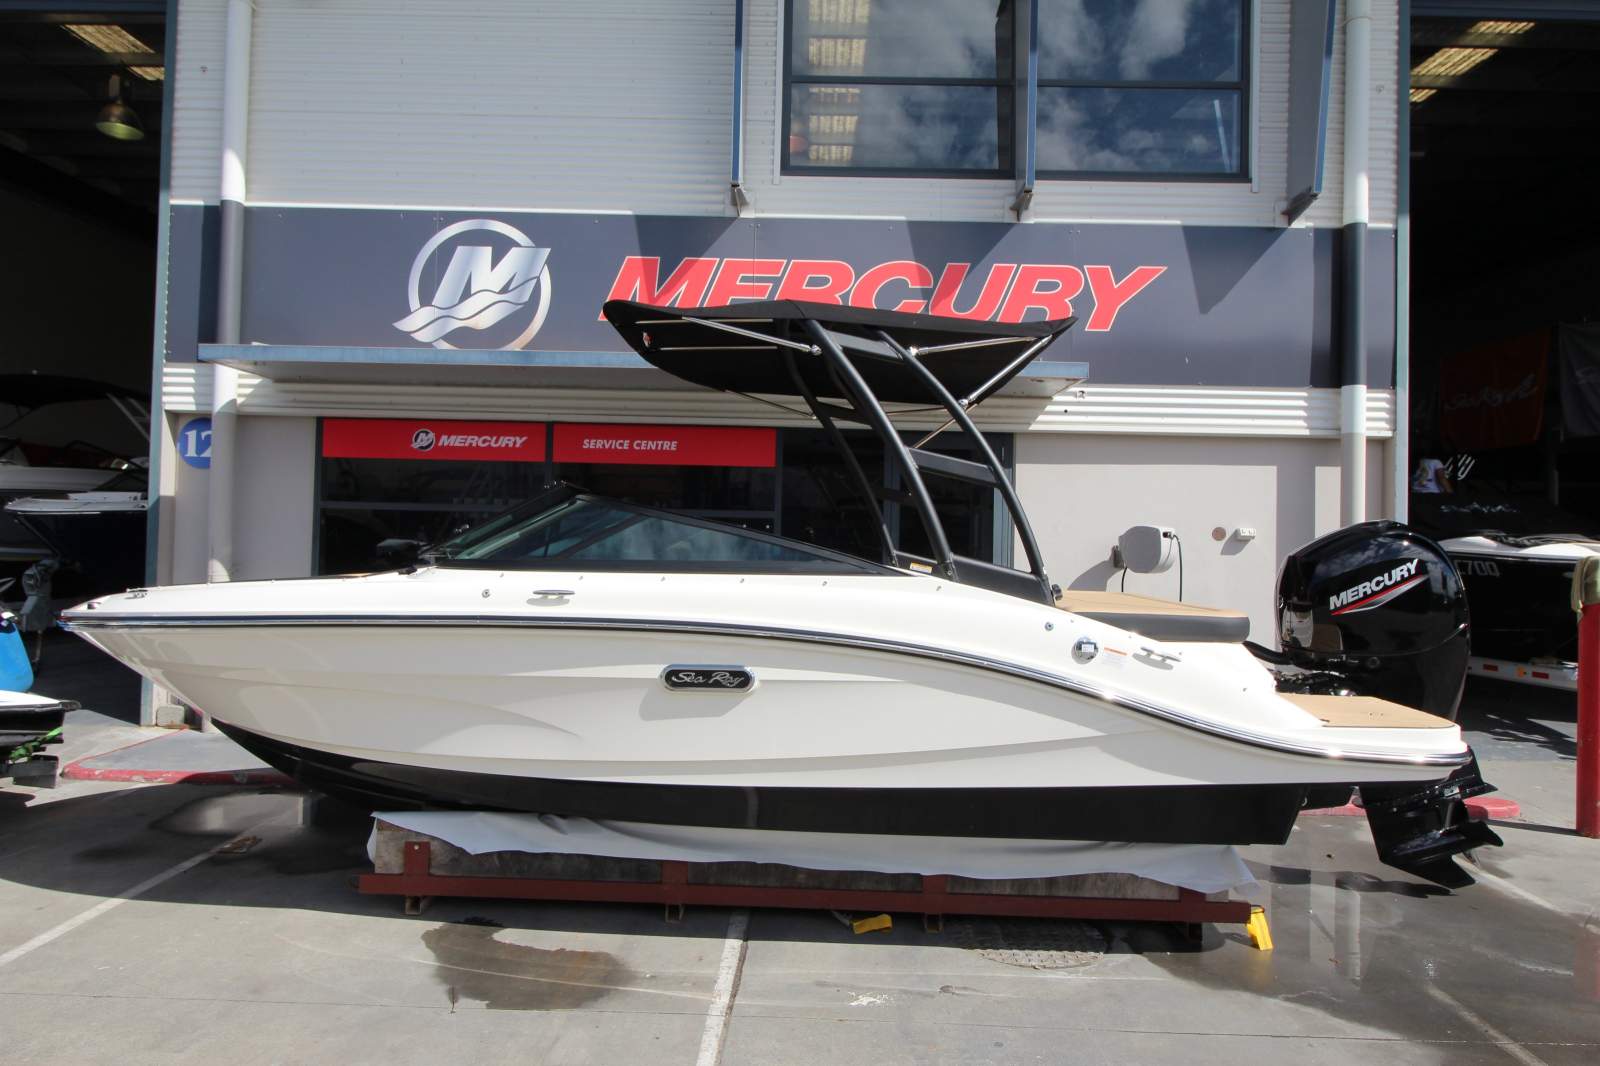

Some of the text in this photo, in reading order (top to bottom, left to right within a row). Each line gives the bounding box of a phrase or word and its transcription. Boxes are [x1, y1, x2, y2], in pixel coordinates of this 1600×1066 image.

[598, 256, 1168, 332] MERCURY
[438, 434, 528, 448] MERCURY
[582, 438, 678, 451] SERVICE CENTRE
[1329, 558, 1418, 610] MERCURY
[671, 671, 744, 687] Sea Ray
